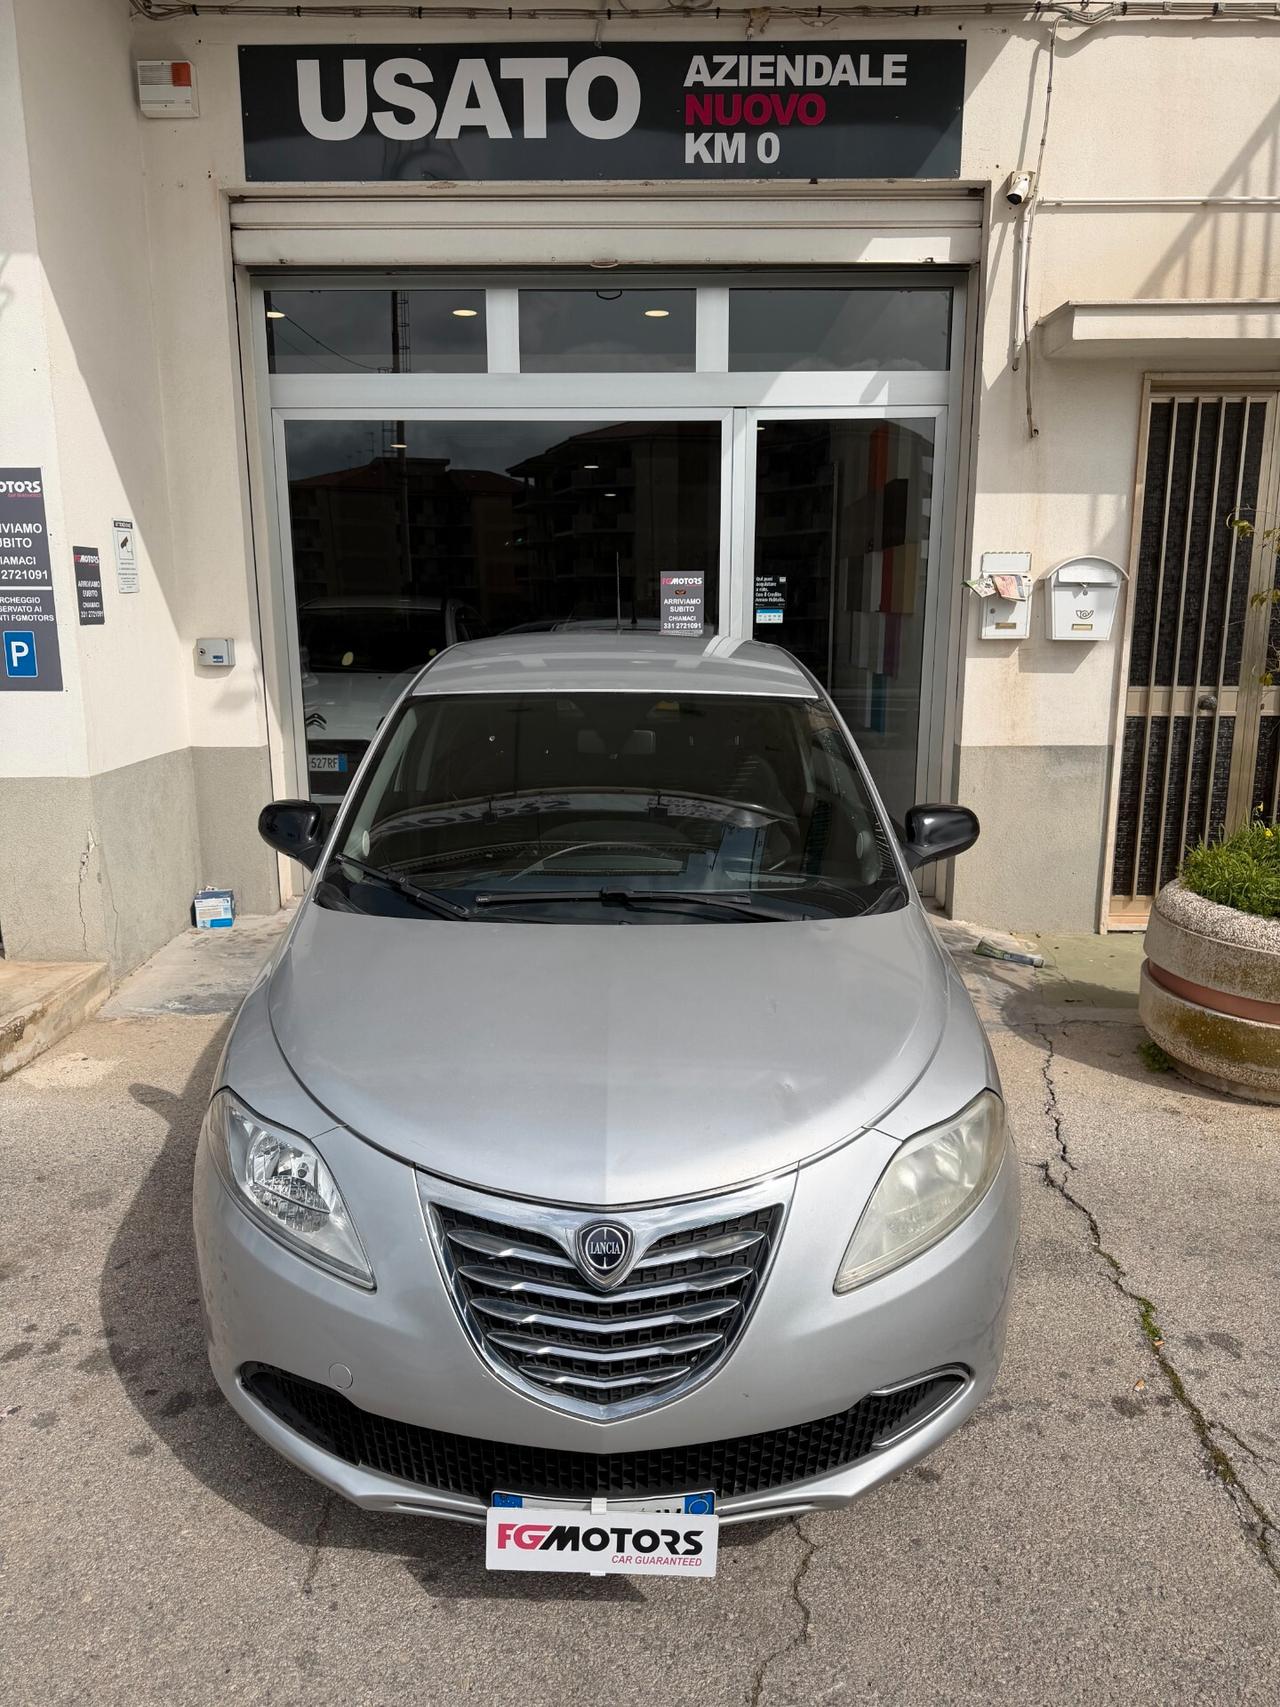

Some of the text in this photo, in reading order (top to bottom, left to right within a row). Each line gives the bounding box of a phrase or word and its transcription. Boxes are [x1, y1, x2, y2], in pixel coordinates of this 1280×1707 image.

[683, 54, 908, 87] AZIENDALE
[297, 56, 641, 140] USATO
[685, 93, 827, 126] NUOVO
[684, 132, 780, 164] KM 0
[0, 537, 32, 548] BITO
[1, 569, 48, 580] 2721091
[34, 605, 42, 613] AI
[11, 614, 55, 622] FGMOTORS
[590, 1241, 621, 1255] LANCIA
[497, 1523, 704, 1556] FGMOTORS
[611, 1555, 703, 1567] CAR GUARANTEED
